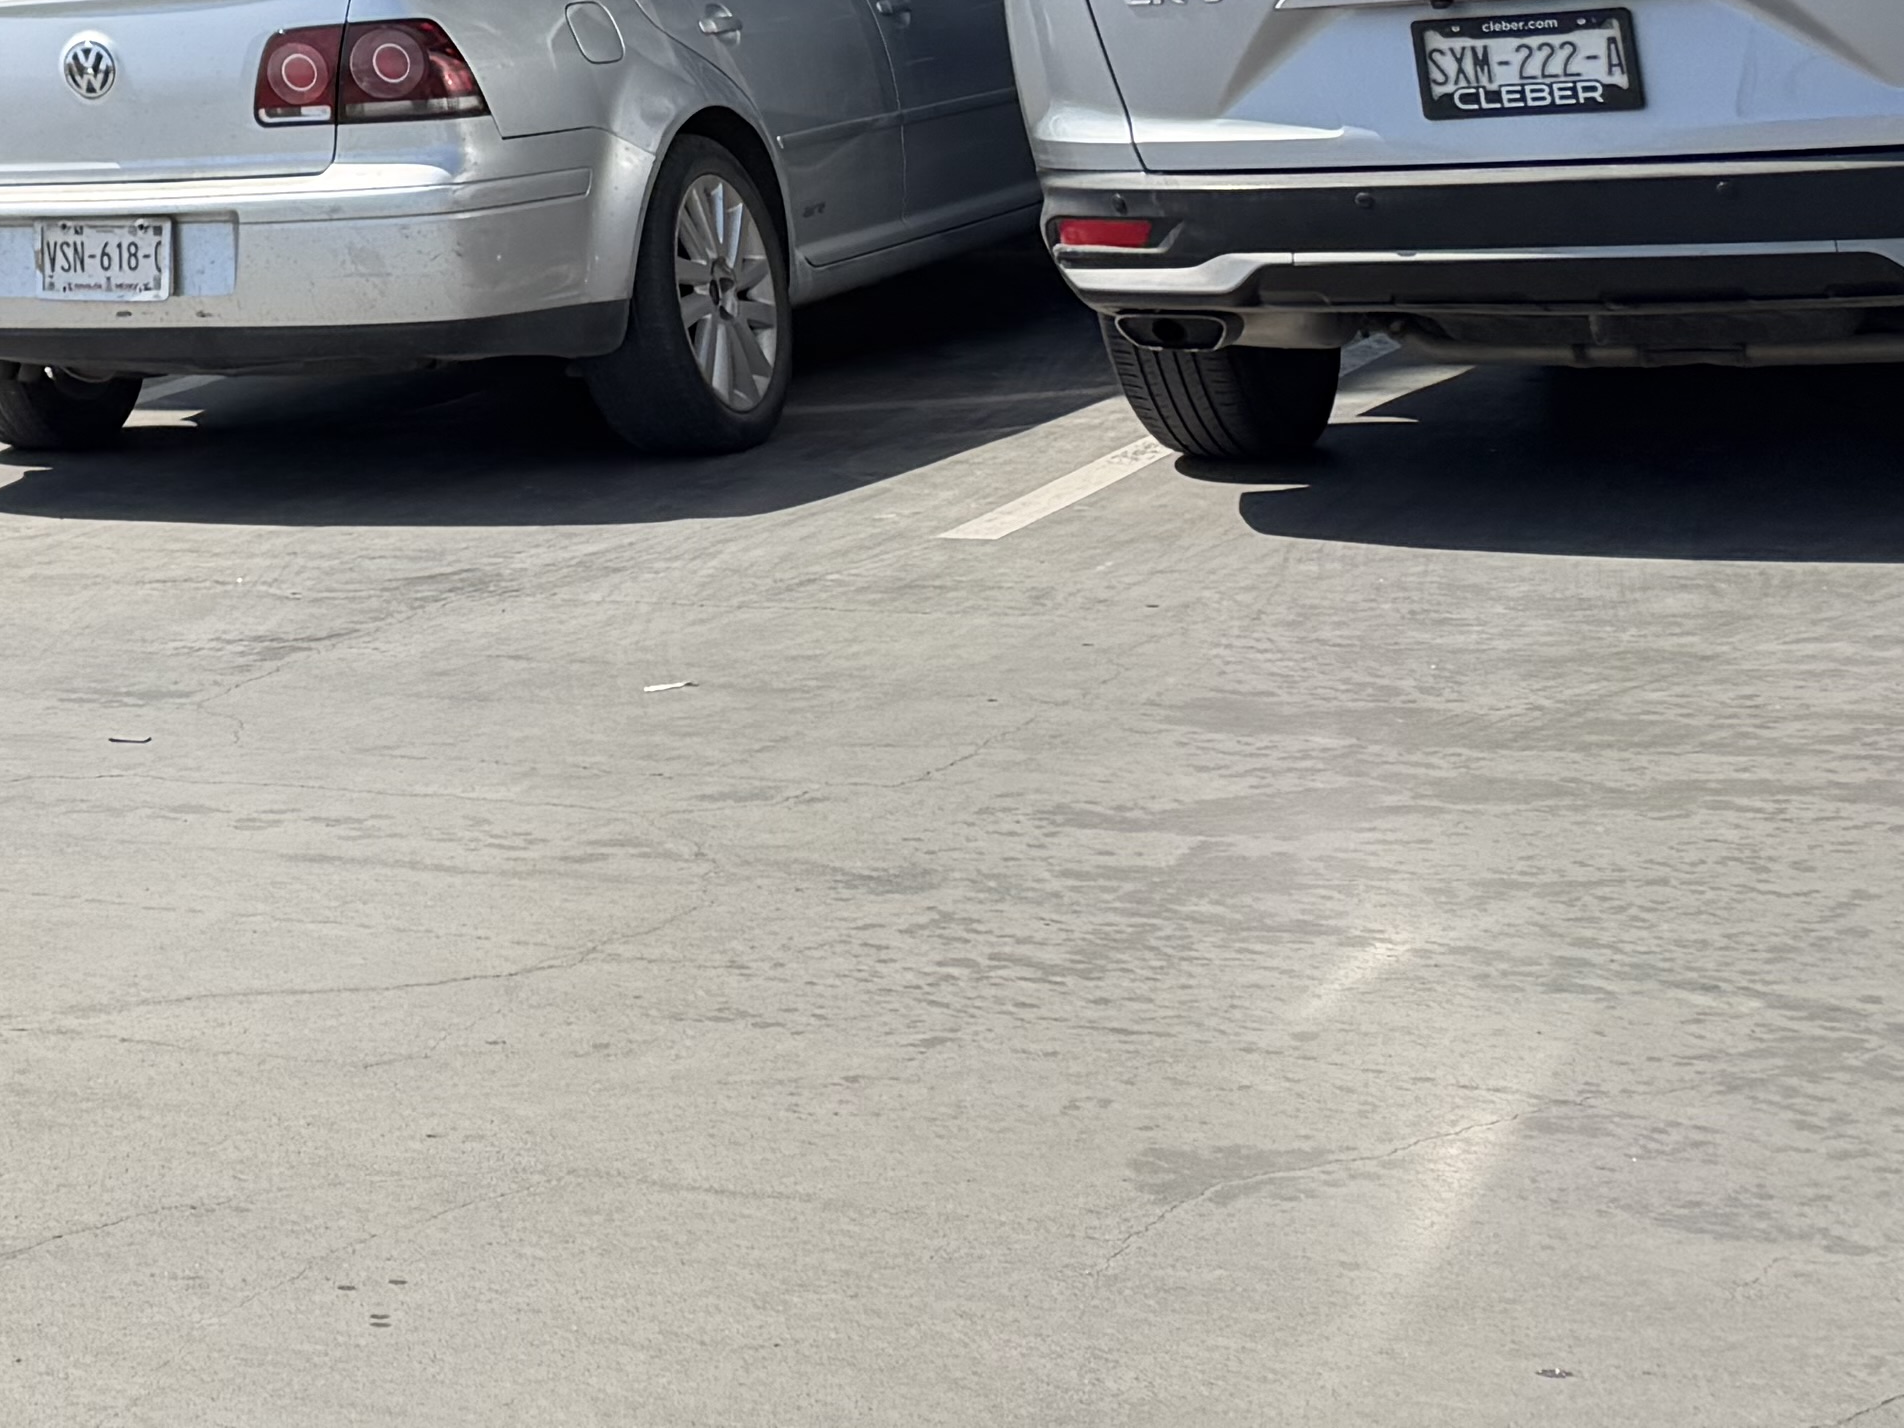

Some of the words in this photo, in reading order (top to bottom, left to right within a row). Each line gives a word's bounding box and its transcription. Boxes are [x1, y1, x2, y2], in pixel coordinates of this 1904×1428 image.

[1481, 18, 1559, 33] cleber.com
[1427, 36, 1627, 87] SXM-222-A
[1453, 80, 1604, 110] CLEBER
